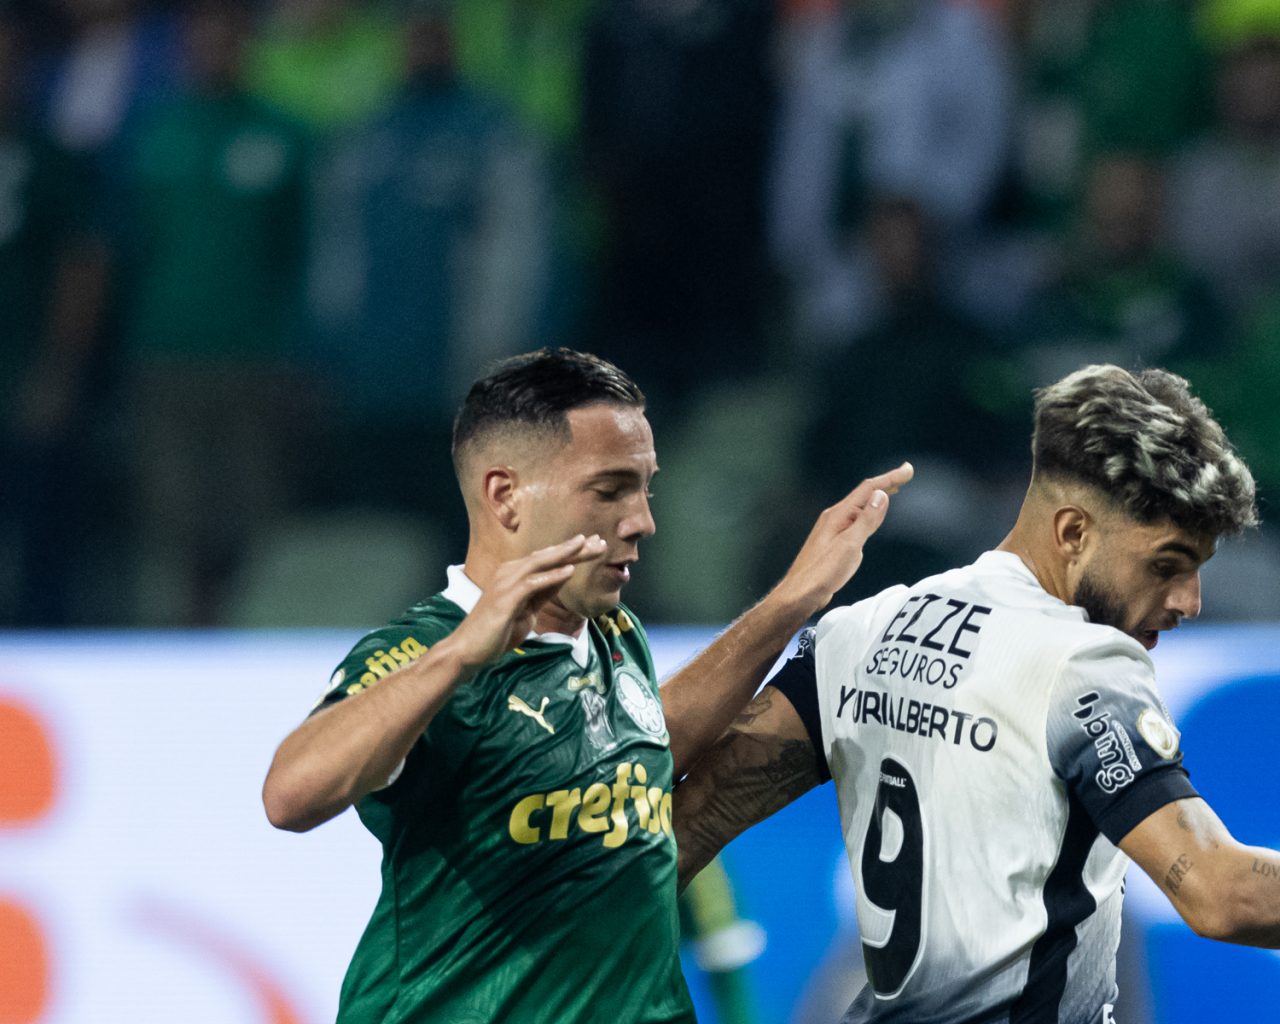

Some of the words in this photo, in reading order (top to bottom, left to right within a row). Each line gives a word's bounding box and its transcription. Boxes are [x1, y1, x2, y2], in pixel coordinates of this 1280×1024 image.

[881, 594, 993, 659] EZZE
[347, 636, 428, 696] efisa
[866, 647, 963, 689] SEGUROS
[1081, 711, 1135, 794] bmg
[860, 755, 926, 998] 9
